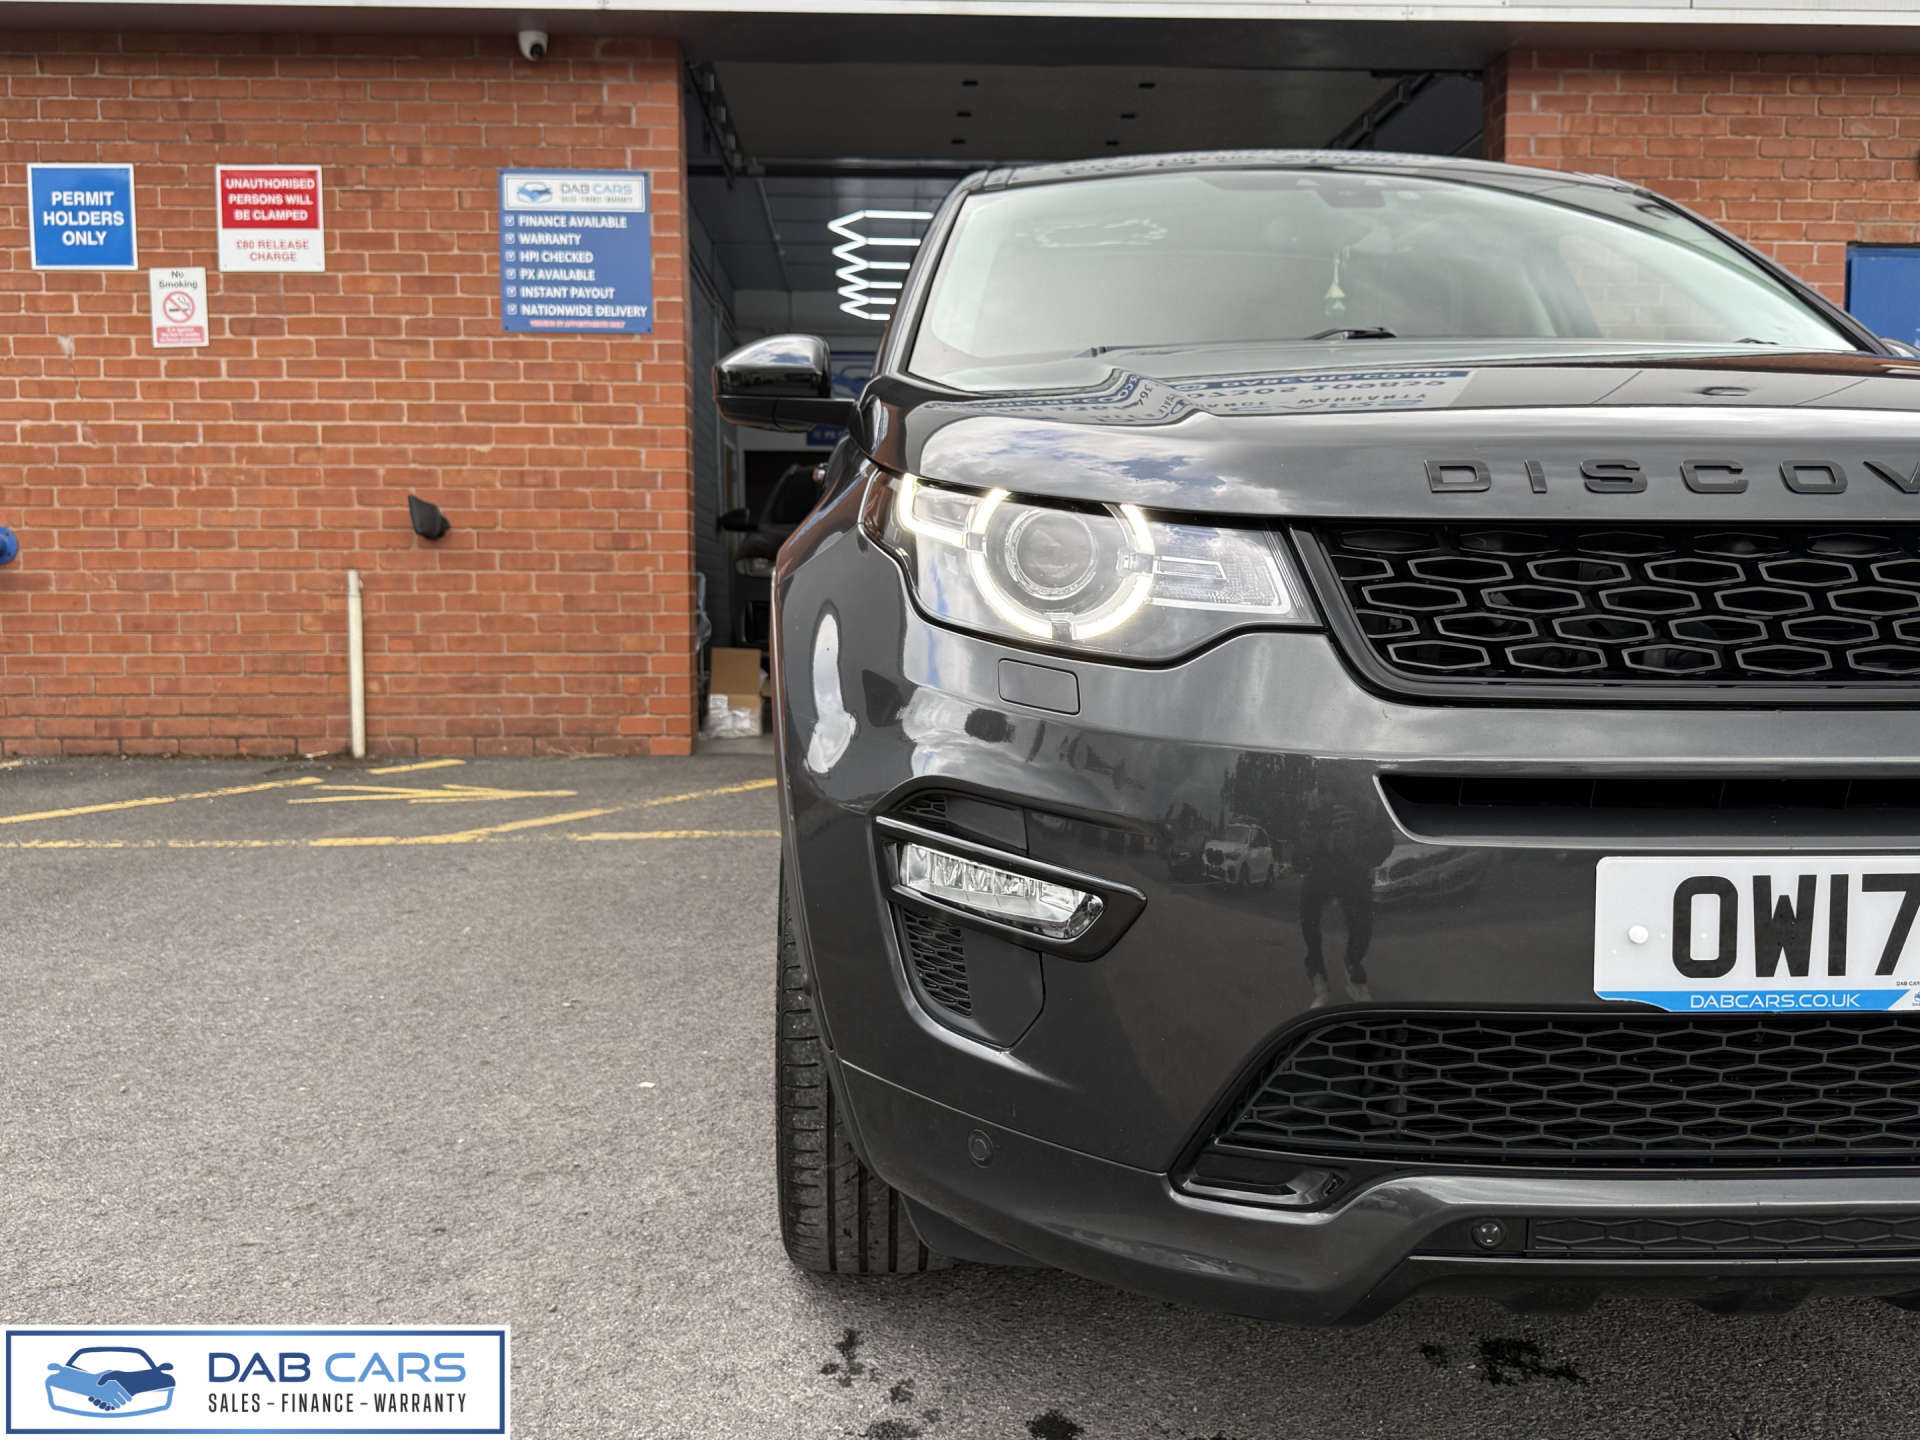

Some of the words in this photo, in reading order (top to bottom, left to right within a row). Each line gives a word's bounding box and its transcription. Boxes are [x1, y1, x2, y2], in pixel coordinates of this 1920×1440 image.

[225, 177, 315, 190] UNAUTHORISED
[51, 191, 114, 207] PERMIT
[228, 194, 282, 205] PERSONS
[284, 194, 313, 205] WILL
[43, 211, 125, 226] HOLDERS
[234, 209, 250, 221] BE
[252, 209, 309, 222] CLAMPED
[518, 215, 567, 228] FINANCE
[569, 216, 628, 229] AVAILABLE
[62, 231, 107, 246] ONLY
[258, 240, 310, 250] RELEASE
[518, 233, 582, 245] WARRANTY
[250, 251, 297, 262] CHARGE
[519, 251, 540, 263] HPI
[541, 251, 594, 263] CHECKED
[171, 270, 185, 280] No
[519, 268, 536, 280] PX
[537, 269, 596, 281] AVAILABLE
[159, 280, 198, 291] Smoking
[520, 286, 568, 299] INSTANT
[570, 287, 616, 300] PAYOUT
[520, 304, 594, 317] NATIONWIDE
[595, 305, 648, 318] DELIVERY
[1672, 873, 1920, 979] OW17
[1690, 993, 1862, 1009] DABCARS.CO.UK
